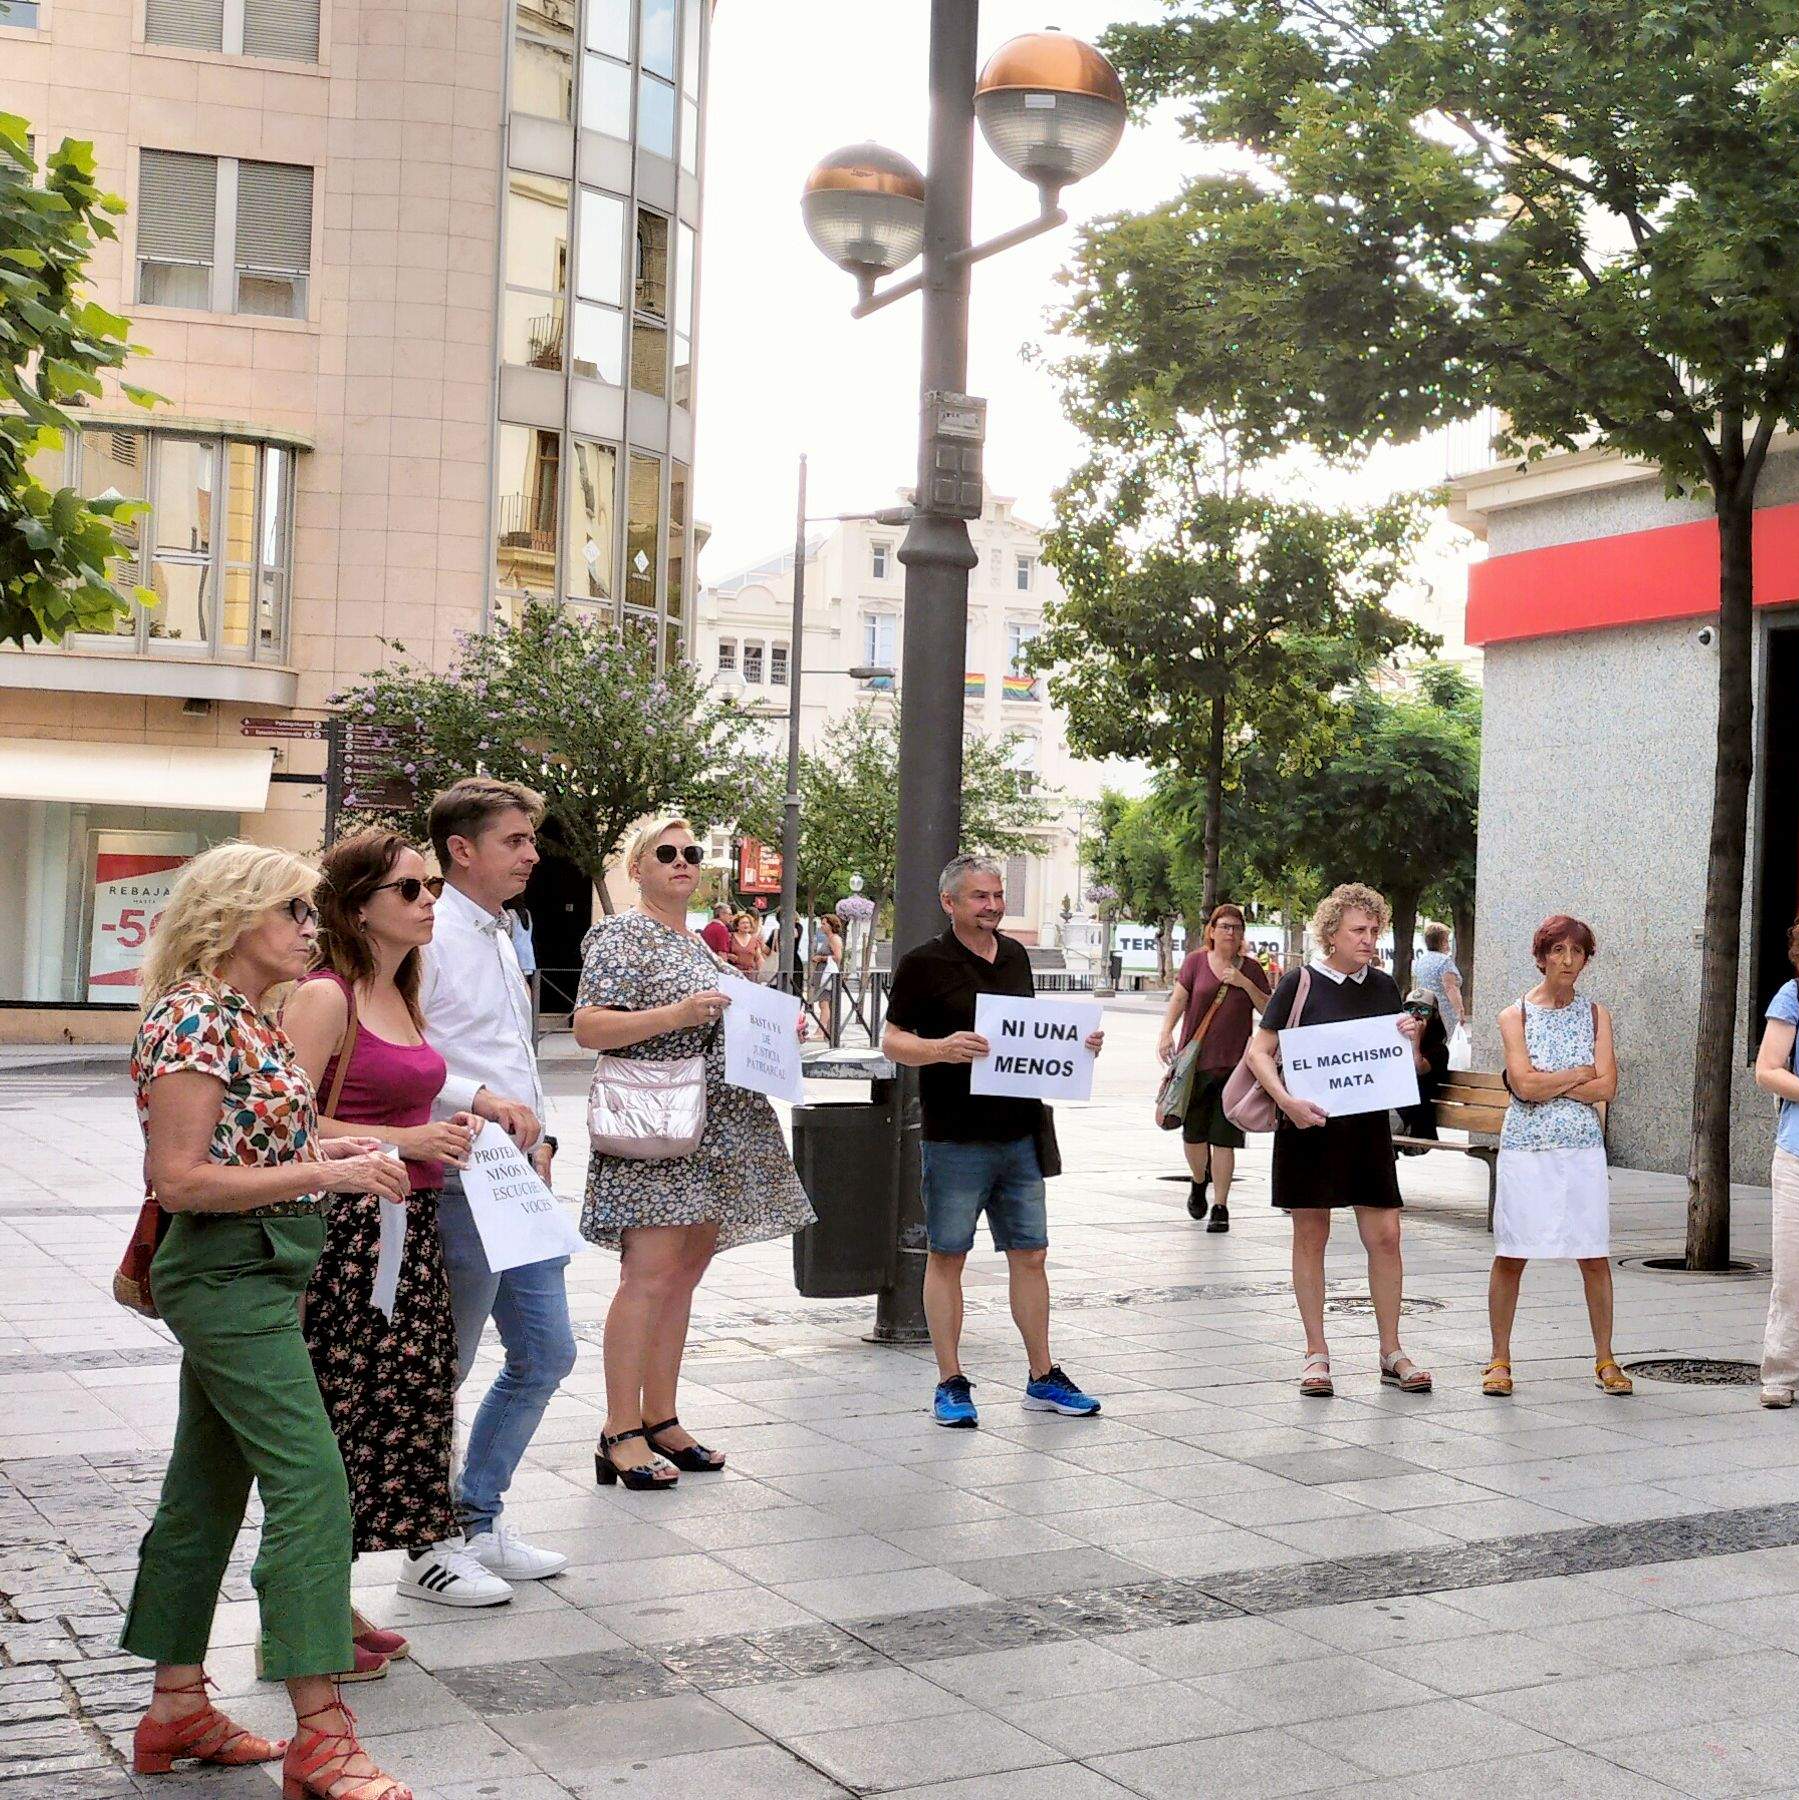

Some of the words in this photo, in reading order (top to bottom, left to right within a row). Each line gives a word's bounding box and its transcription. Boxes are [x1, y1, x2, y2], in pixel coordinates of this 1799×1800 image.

[1001, 1019, 1025, 1038] NI
[1034, 1021, 1079, 1042] UNA
[994, 1055, 1075, 1077] MENOS
[1292, 1058, 1312, 1071] EL
[1317, 1045, 1403, 1068] MACHISMO
[1329, 1073, 1375, 1090] MATA
